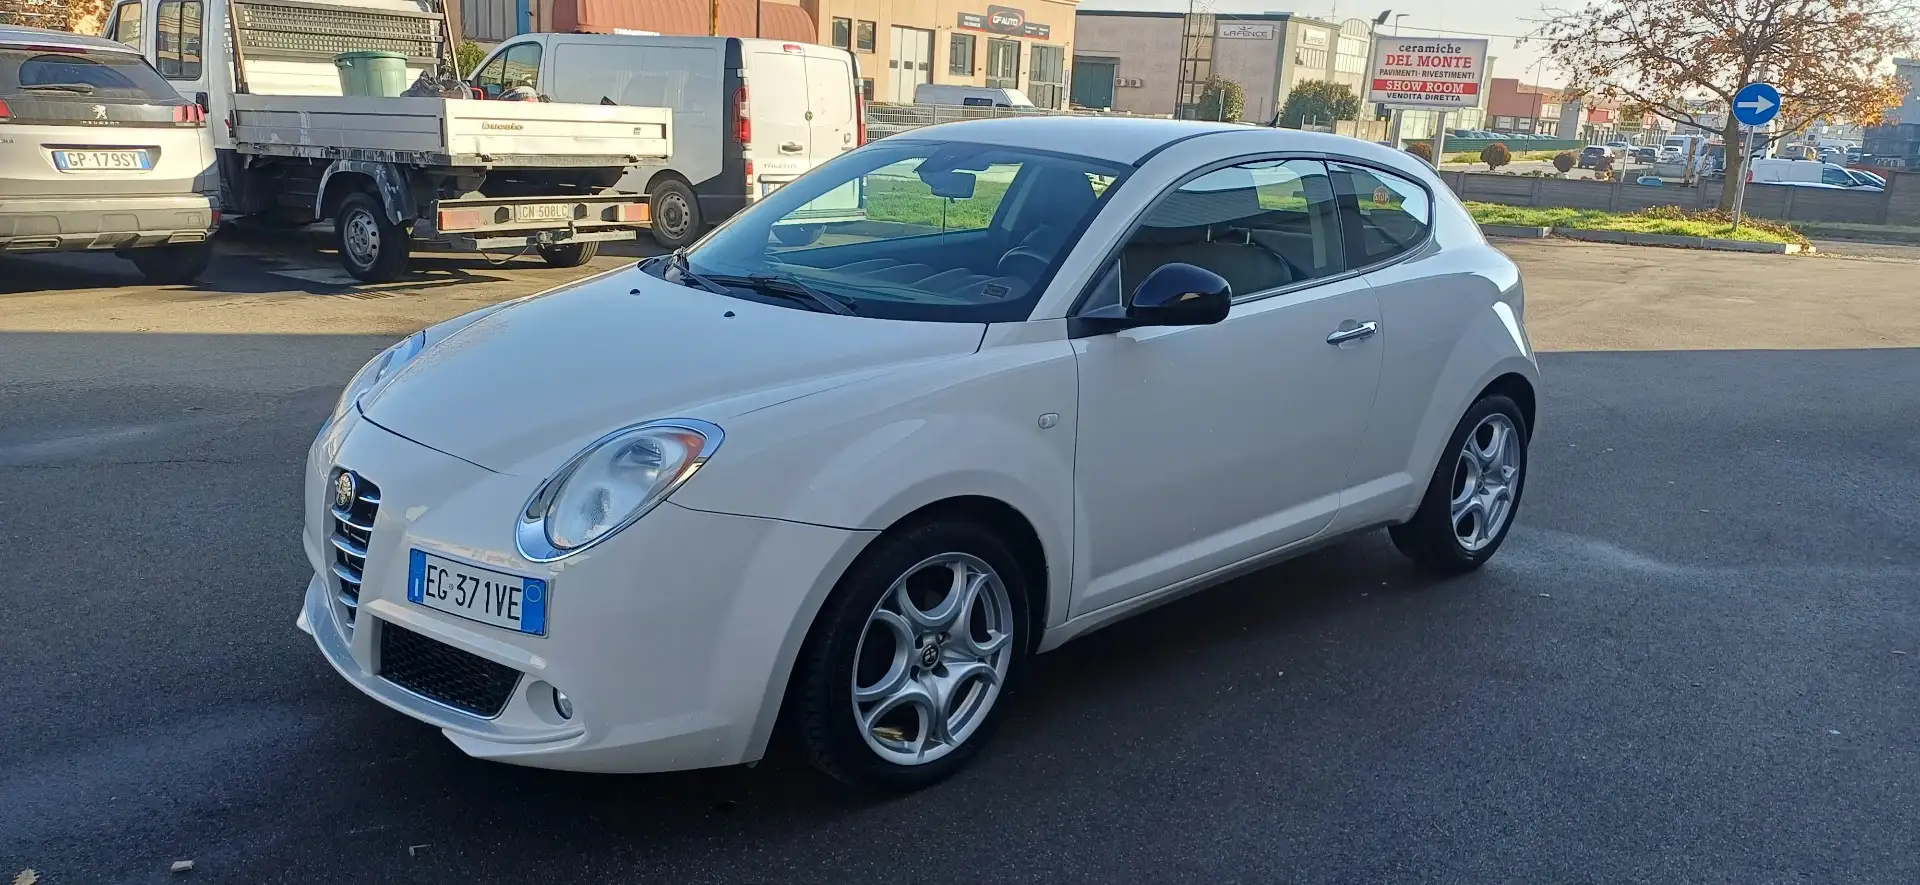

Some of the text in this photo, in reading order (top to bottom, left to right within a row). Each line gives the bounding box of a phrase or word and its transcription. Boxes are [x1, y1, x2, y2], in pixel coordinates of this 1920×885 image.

[1399, 43, 1462, 54] ceramiche
[1385, 54, 1472, 69] DEL MONTE
[1385, 80, 1465, 93] SHOW ROOM
[1386, 92, 1461, 102] VENDITA DIRETTA
[522, 205, 535, 218] CN
